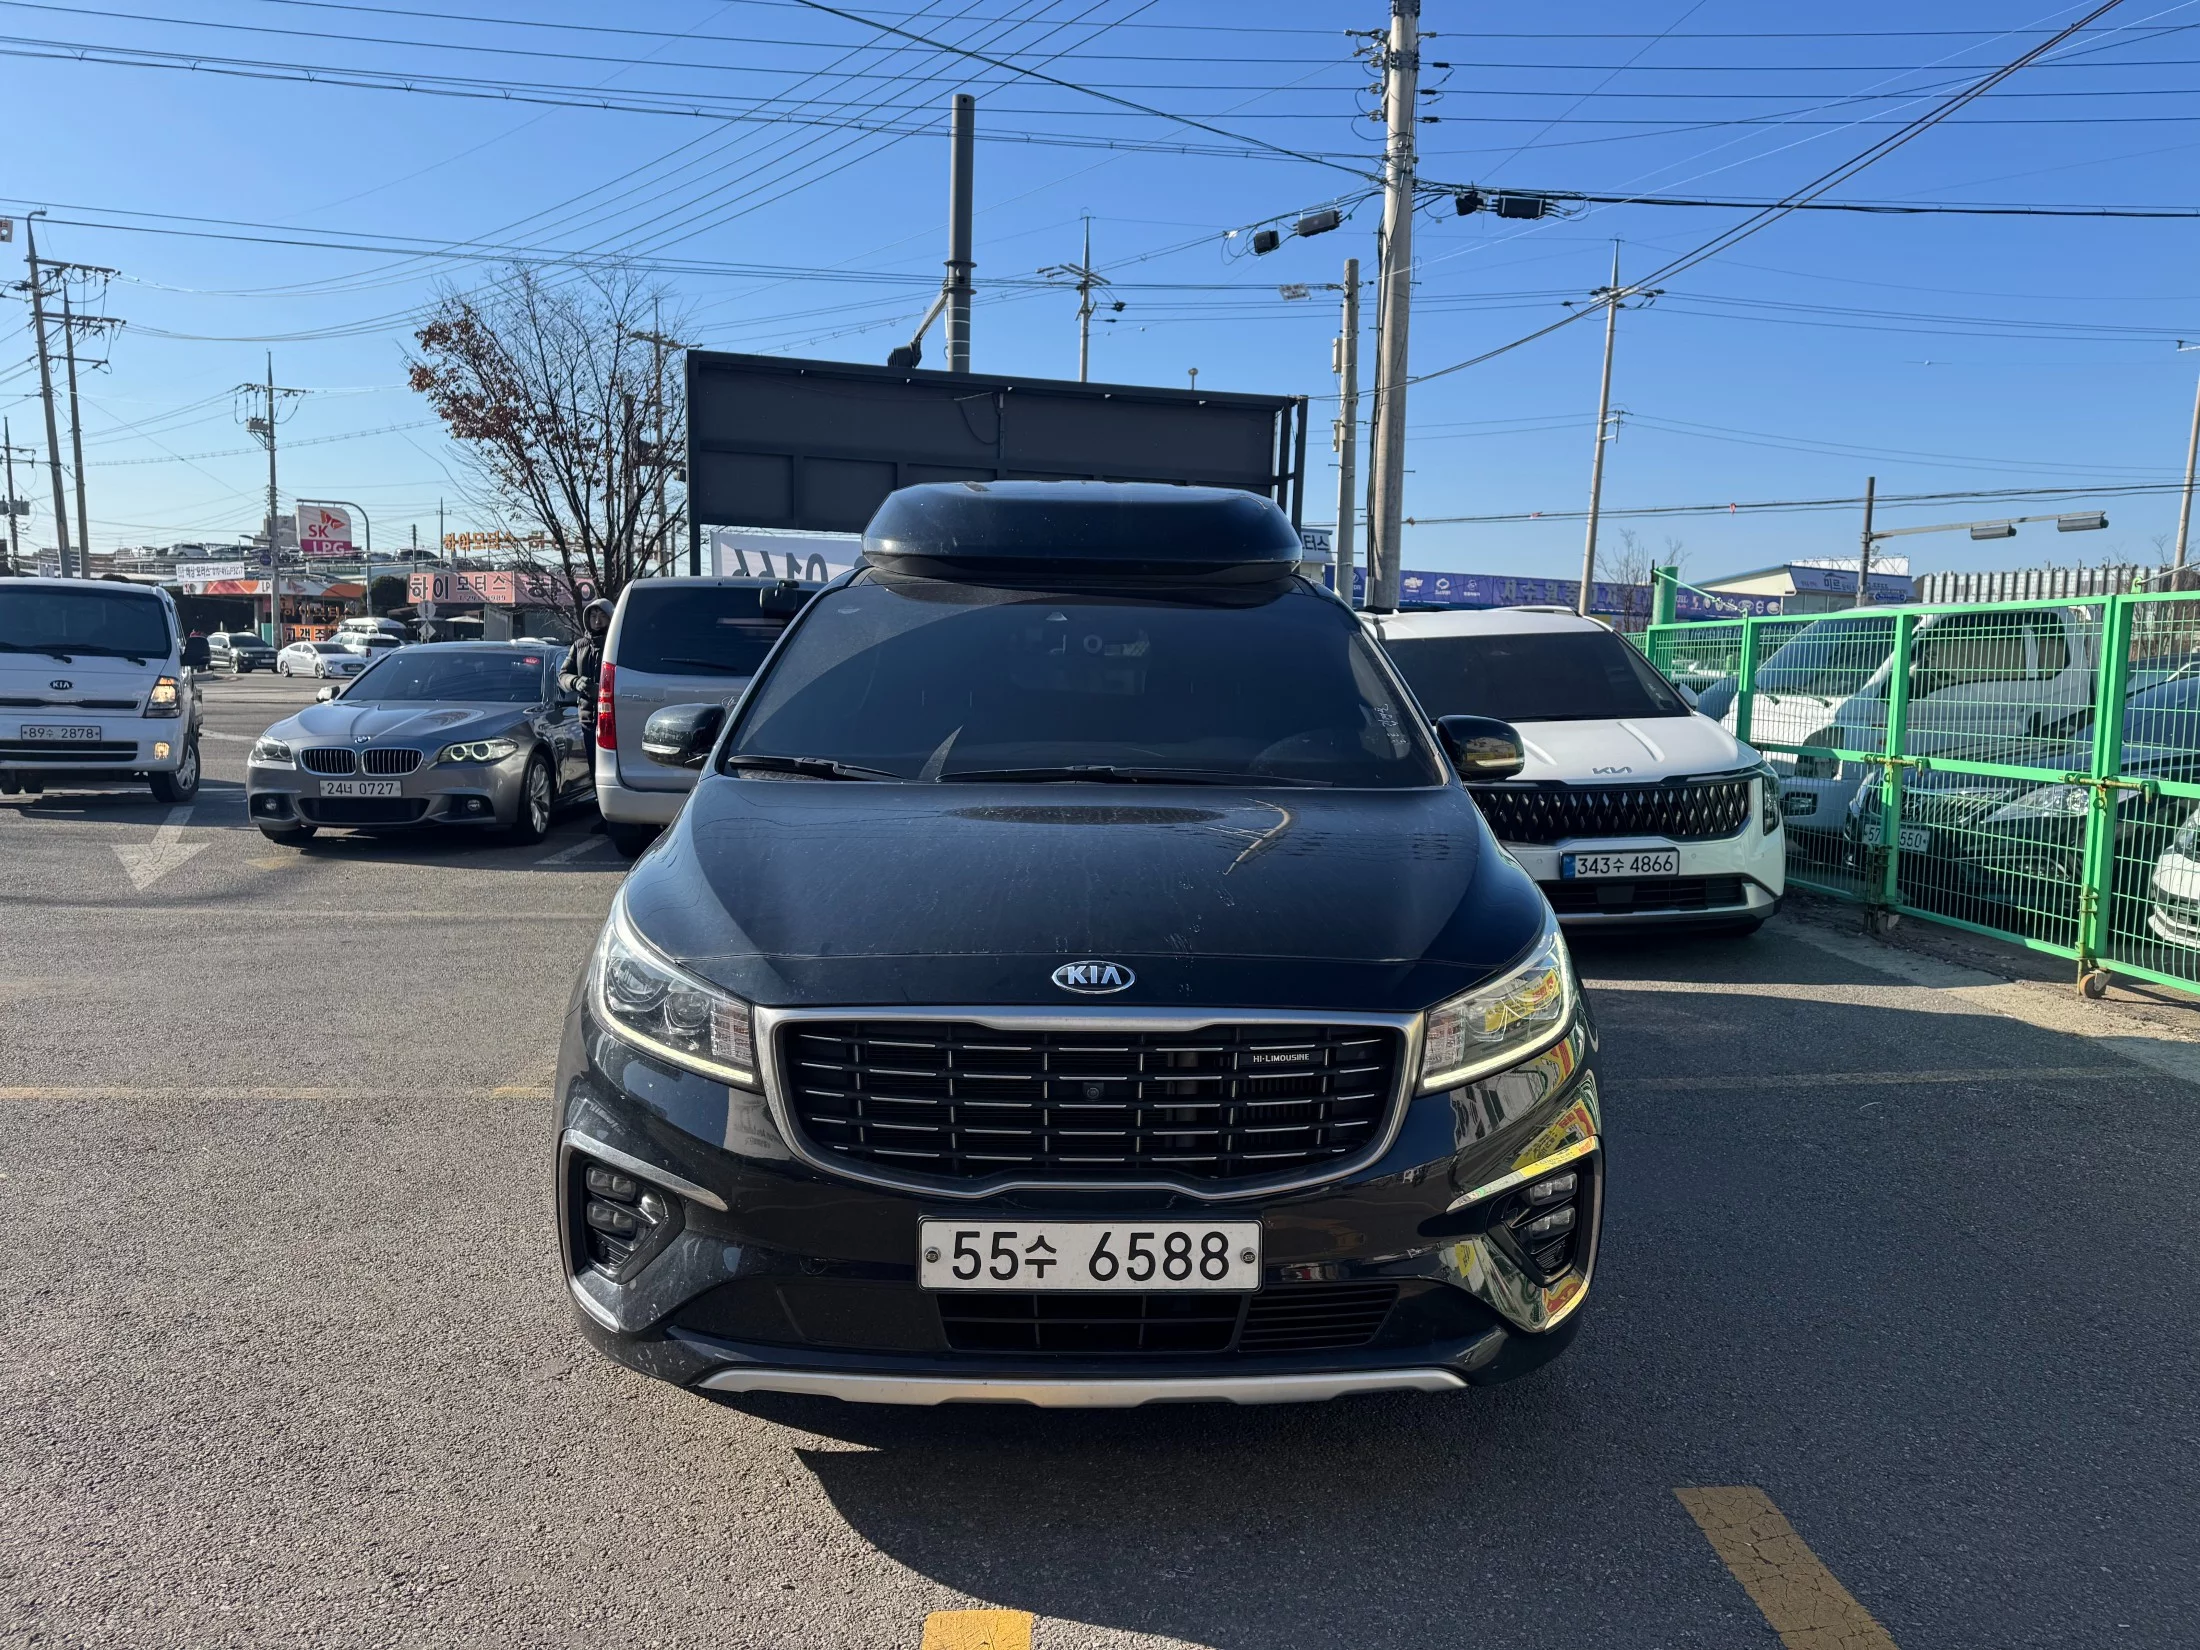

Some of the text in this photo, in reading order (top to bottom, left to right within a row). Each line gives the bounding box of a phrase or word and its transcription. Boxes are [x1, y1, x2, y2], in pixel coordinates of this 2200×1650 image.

[308, 524, 329, 538] SK
[313, 541, 345, 556] LPG
[1302, 534, 1331, 551] 터스
[261, 581, 271, 592] LP
[411, 576, 449, 599] 하이
[456, 574, 506, 592] 모터스
[28, 727, 94, 738] 89수 2878
[359, 782, 394, 795] 0727
[1900, 831, 1923, 848] 550
[1577, 854, 1673, 875] 343수 4866
[1066, 965, 1122, 985] KIA
[952, 1231, 1229, 1281] 55수 6588
